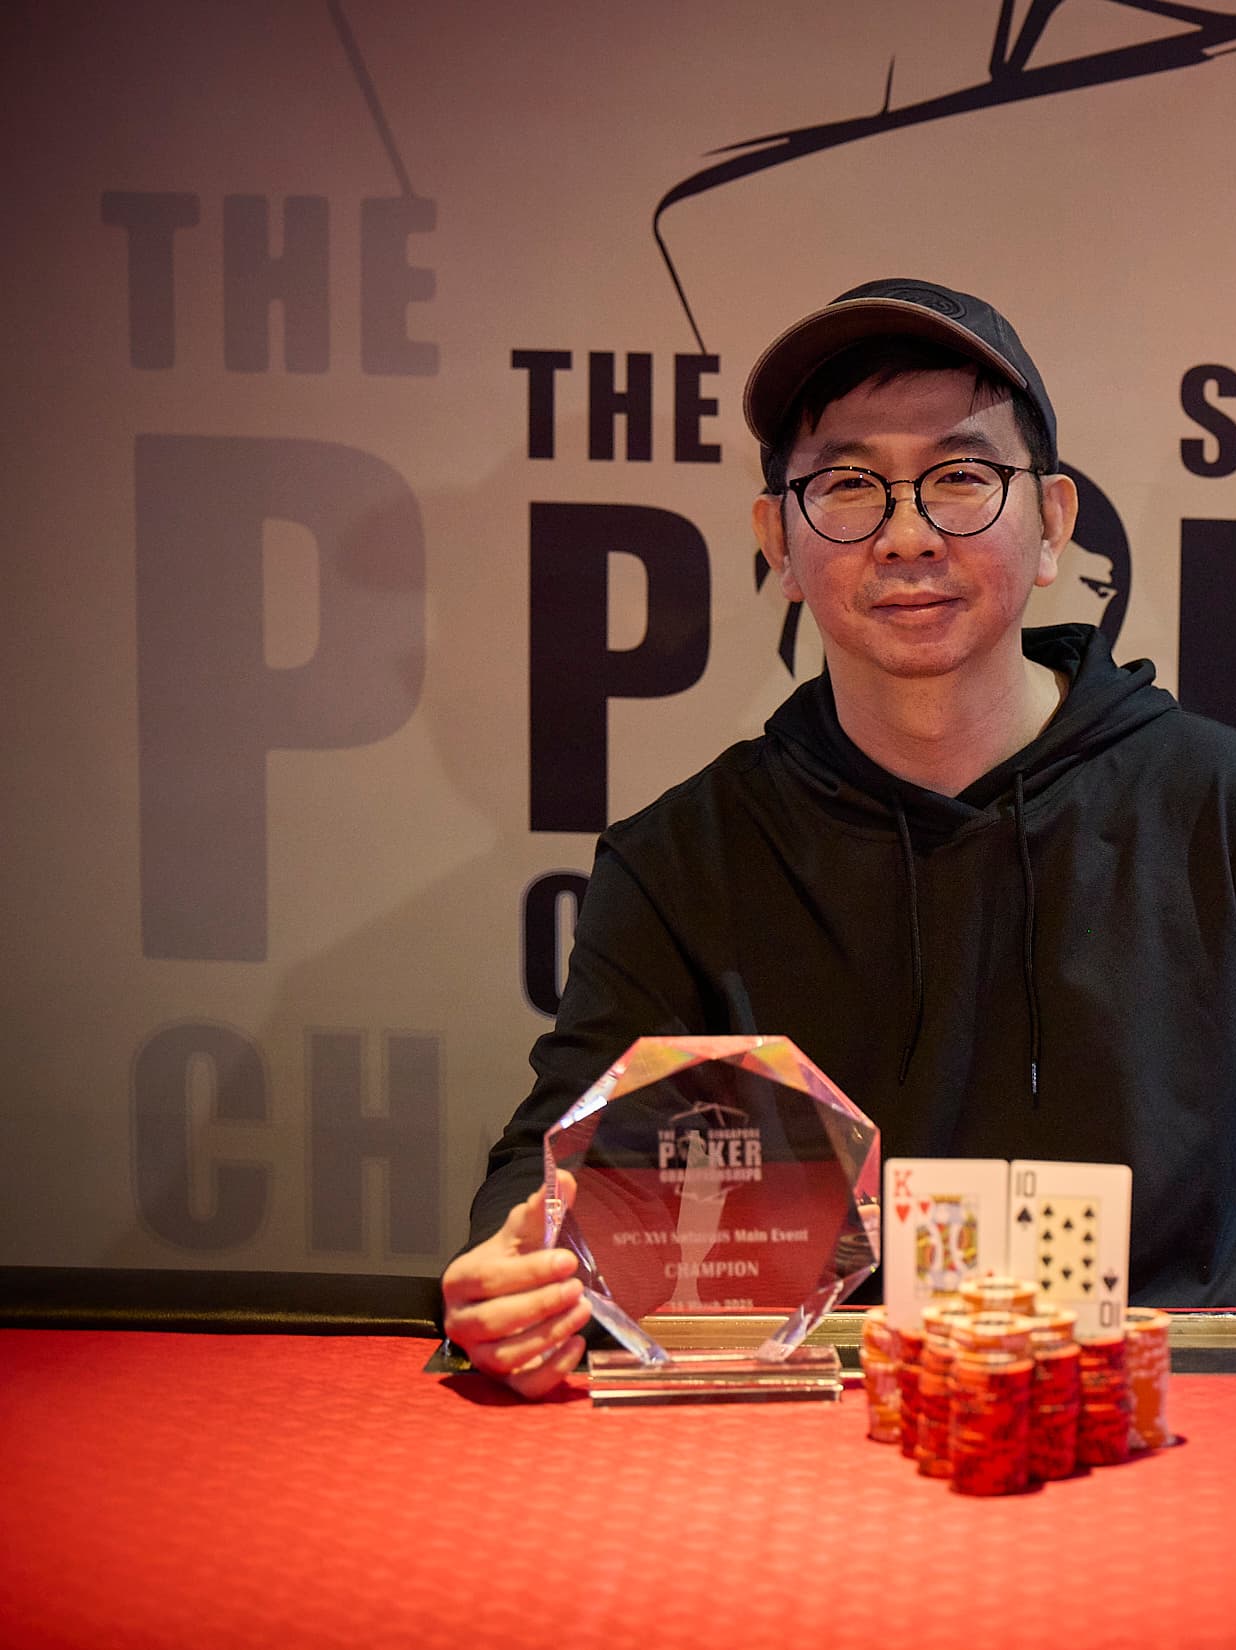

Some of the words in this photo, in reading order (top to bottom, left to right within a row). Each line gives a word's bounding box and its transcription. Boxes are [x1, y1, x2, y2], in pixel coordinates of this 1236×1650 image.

[101, 191, 440, 376] THE
[511, 350, 721, 464] THE
[893, 1170, 913, 1198] K
[1015, 1170, 1037, 1198] 10
[734, 1228, 768, 1243] Main
[771, 1227, 809, 1243] Event
[664, 1260, 760, 1279] CHAMPION
